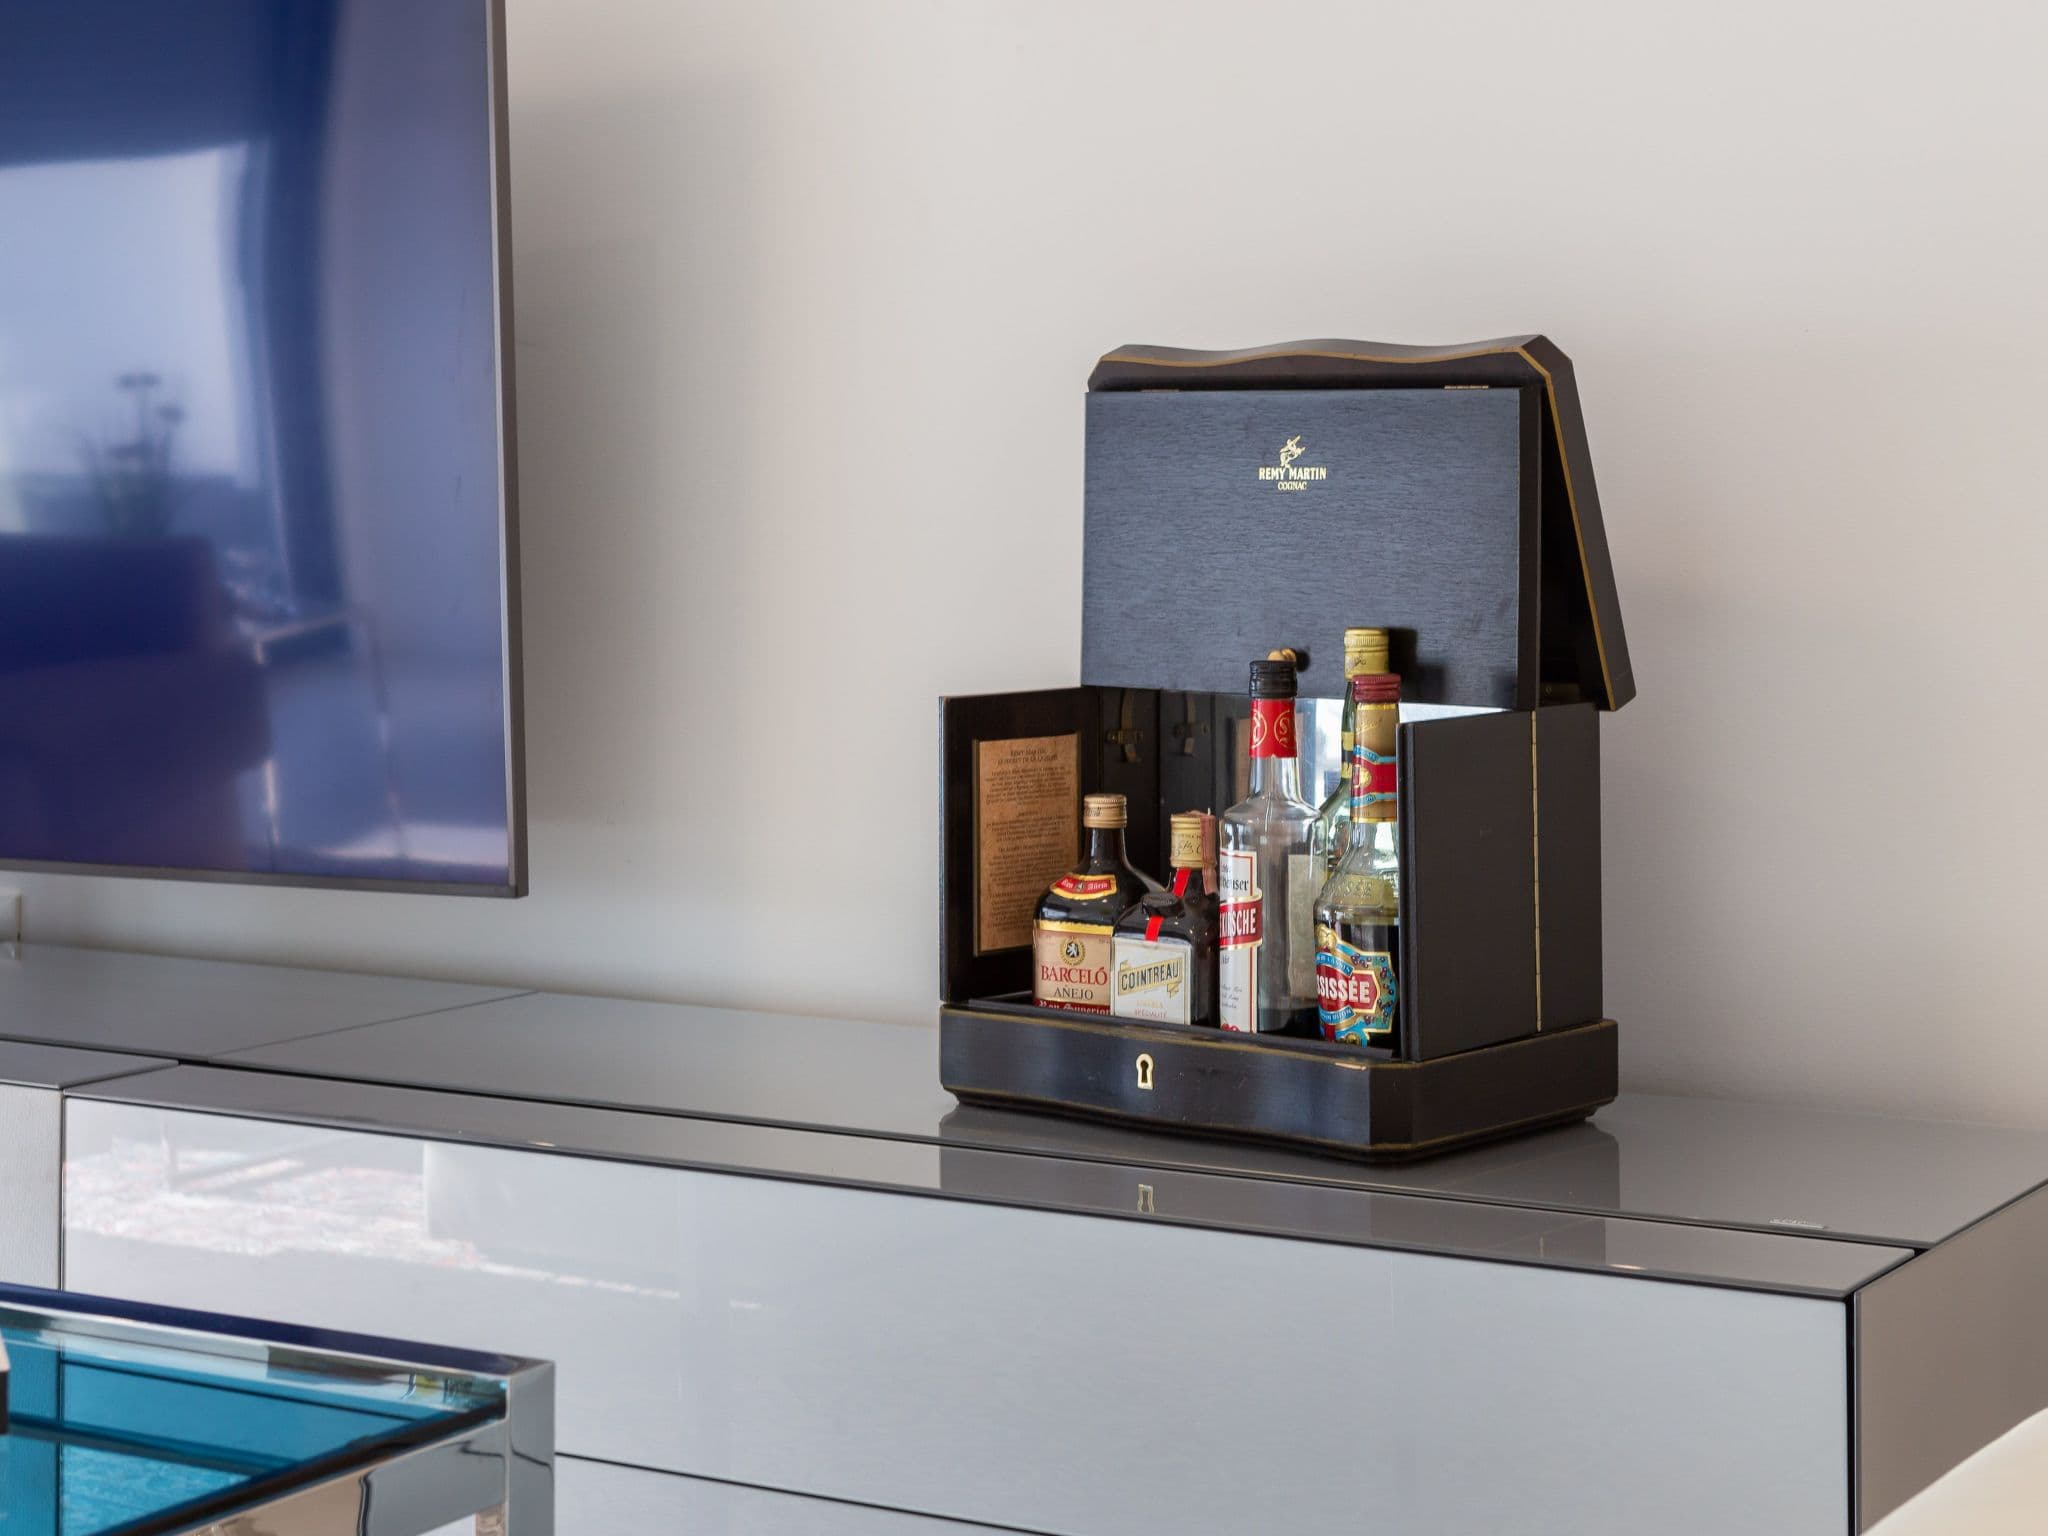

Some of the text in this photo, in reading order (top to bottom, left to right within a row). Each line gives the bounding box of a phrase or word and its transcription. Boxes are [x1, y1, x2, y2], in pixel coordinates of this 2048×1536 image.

[1289, 467, 1327, 480] MARTIN
[1278, 481, 1307, 490] COGNAC
[1041, 965, 1108, 986] BARCELÓ
[1121, 960, 1179, 991] COINTREAU
[1054, 984, 1094, 1000] AÑEJO
